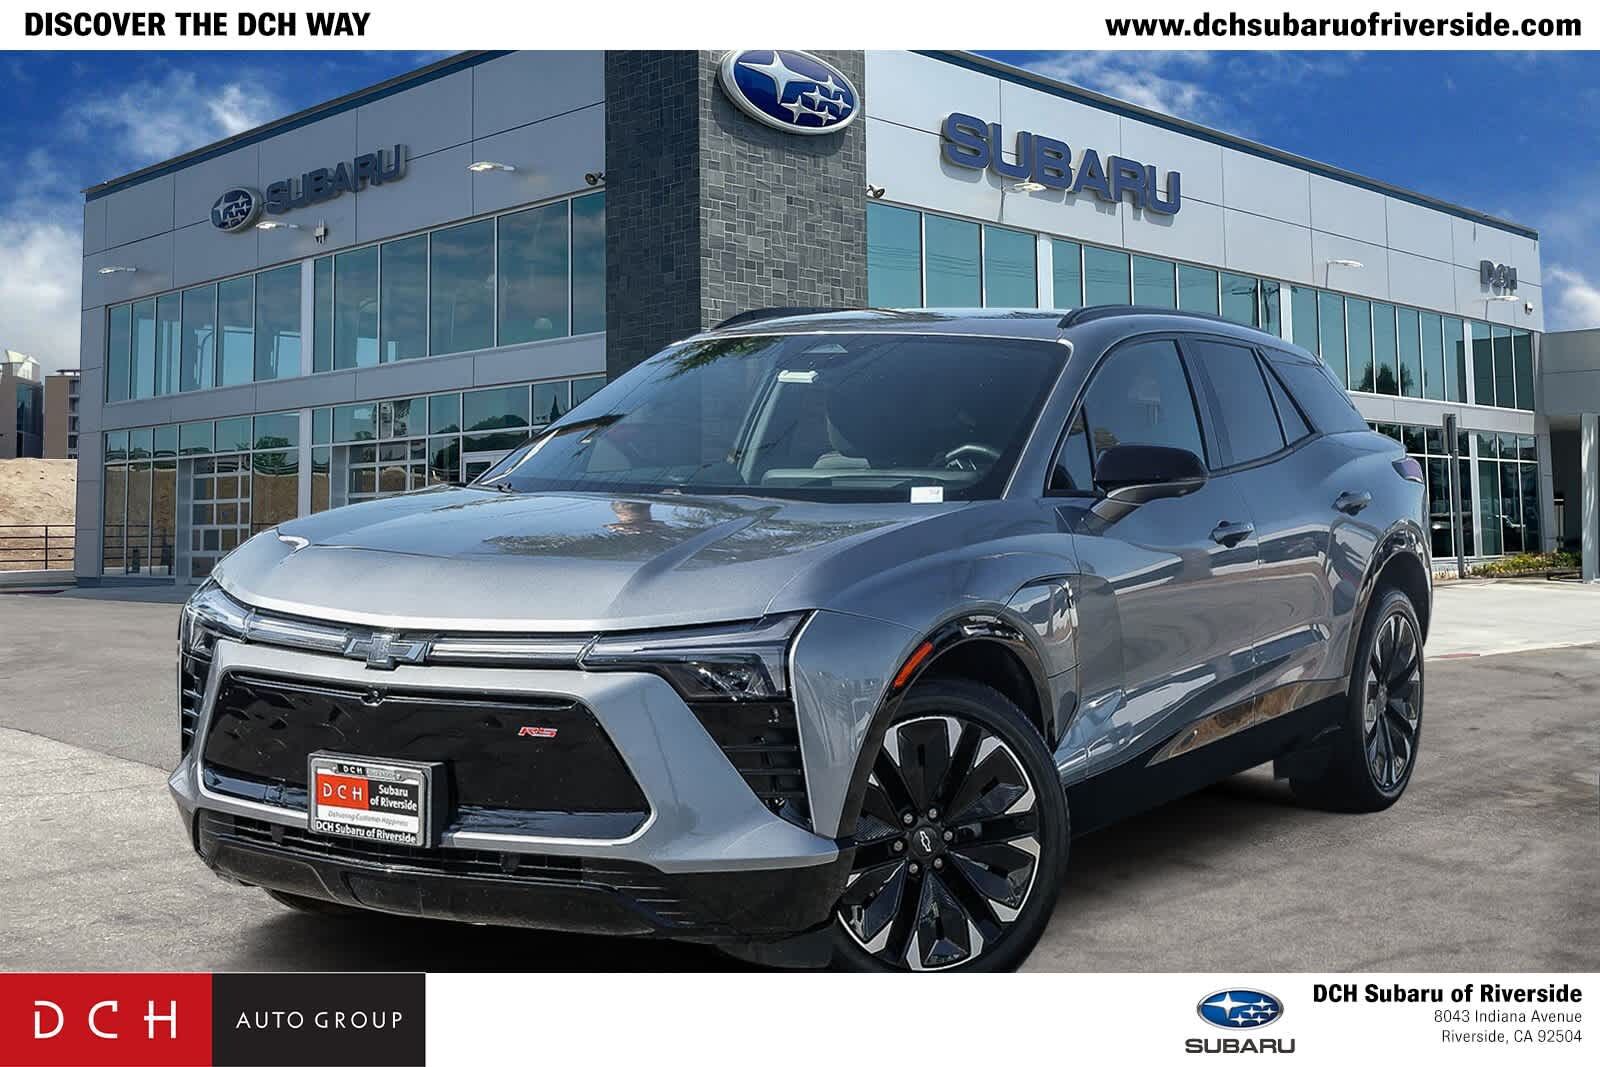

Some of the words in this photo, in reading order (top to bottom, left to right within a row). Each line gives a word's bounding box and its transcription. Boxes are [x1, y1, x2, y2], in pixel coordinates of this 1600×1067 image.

[941, 112, 1181, 215] SUBARU
[266, 144, 408, 215] SUBARU
[518, 726, 558, 738] RS
[343, 764, 363, 775] DCH
[323, 783, 363, 801] DCH
[378, 784, 408, 797] Subaru
[369, 796, 379, 806] of
[380, 797, 417, 811] Riverside
[316, 820, 334, 832] DCH
[335, 823, 365, 837] Subaru
[366, 828, 376, 838] of
[376, 829, 416, 843] Riverside
